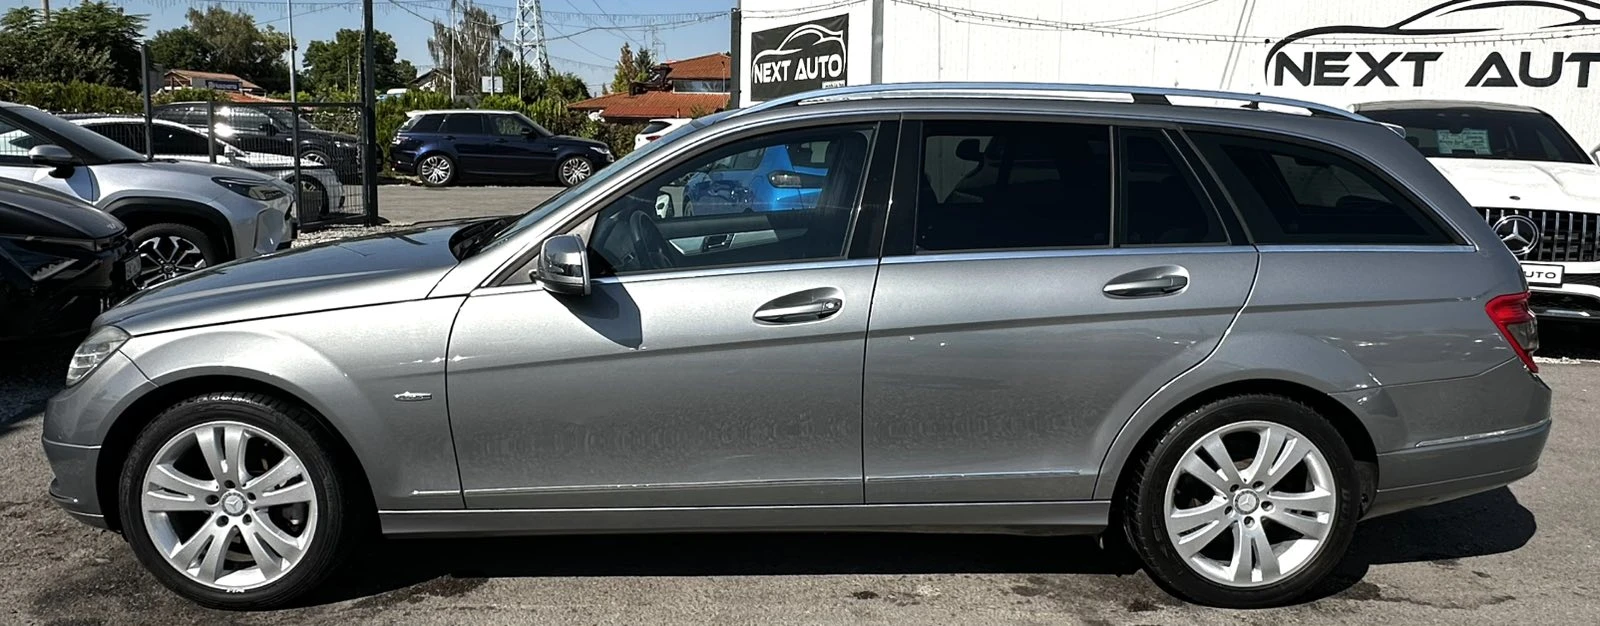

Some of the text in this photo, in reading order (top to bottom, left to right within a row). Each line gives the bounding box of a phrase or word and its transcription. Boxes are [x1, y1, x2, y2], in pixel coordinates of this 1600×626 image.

[754, 54, 842, 84] NEXT AUTO
[1274, 51, 1600, 88] NEXT AUT
[1523, 271, 1556, 279] UTO
